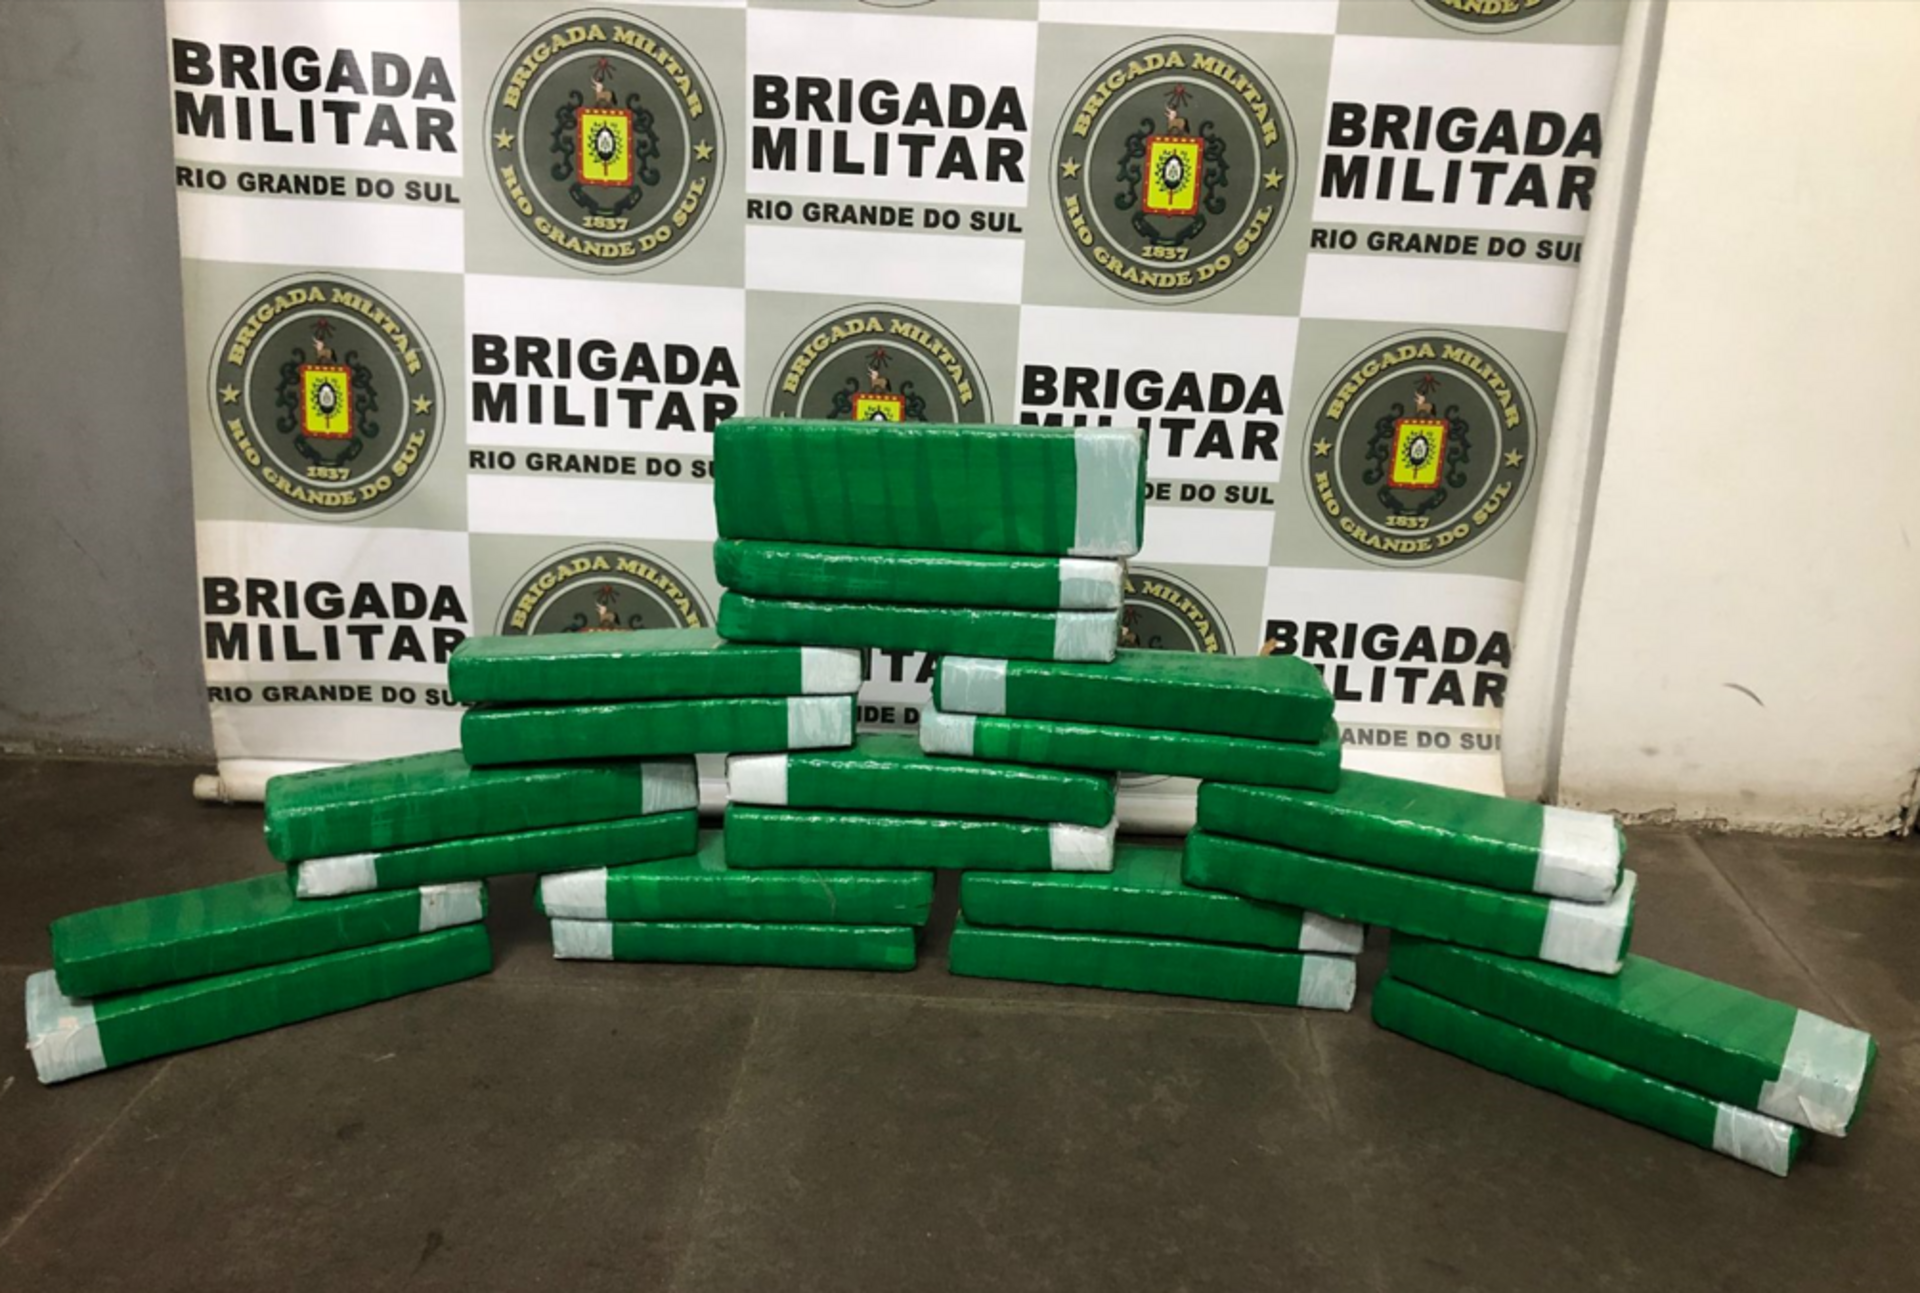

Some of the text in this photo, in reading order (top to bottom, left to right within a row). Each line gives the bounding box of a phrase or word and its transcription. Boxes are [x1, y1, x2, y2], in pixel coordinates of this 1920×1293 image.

[171, 38, 457, 102] BRIGADA
[503, 25, 703, 118] BRIGADA MILITAR
[173, 90, 457, 153] MILITAR
[753, 74, 1027, 132] BRIGADA
[1073, 51, 1278, 146] BRIGADA MILITAR
[752, 126, 1025, 182] MILITAR
[1327, 101, 1601, 159] BRIGADA
[176, 165, 460, 203] RIO GRANDE DO SUL
[1320, 154, 1597, 211] MILITAR
[500, 165, 707, 258] RIO GRANDE DO SUL
[582, 215, 628, 231] 1837
[747, 199, 1023, 233] RIO GRANDE DO SUL
[1065, 194, 1273, 287] RIO GRANDE DO SUL
[1142, 246, 1188, 260] 1837
[1310, 229, 1357, 249] RIO
[1367, 231, 1478, 256] GRANDE
[1487, 237, 1526, 258] DO
[229, 287, 421, 375] BRIGADA MILITAR
[472, 334, 740, 389] BRIGADA
[783, 317, 974, 407] BRIGADA MILITAR
[1327, 343, 1520, 428] BRIGADA MILITAR
[472, 381, 739, 433] MILITAR
[1021, 364, 1284, 415] BRIGADA
[229, 419, 426, 506] RIO GRANDE DO SUL
[307, 465, 350, 480] 1837
[469, 450, 516, 469] RIO
[525, 452, 636, 476] GRANDE
[646, 457, 682, 477] DO
[1180, 484, 1215, 501] DO
[1224, 485, 1274, 504] SUL
[1316, 472, 1512, 553] RIO GRANDE DO SUL
[1385, 515, 1430, 529] 1837
[203, 576, 468, 623] BRIGADA
[511, 556, 610, 629] BRIGADA
[1142, 581, 1219, 653] MILITAR
[205, 621, 466, 664] MILITAR
[1265, 620, 1511, 669] BRIGADA
[208, 684, 473, 707] RIO GRANDE DO SU
[1314, 664, 1507, 708] LITAR
[1340, 728, 1407, 747] ANDE
[1417, 731, 1451, 749] DO
